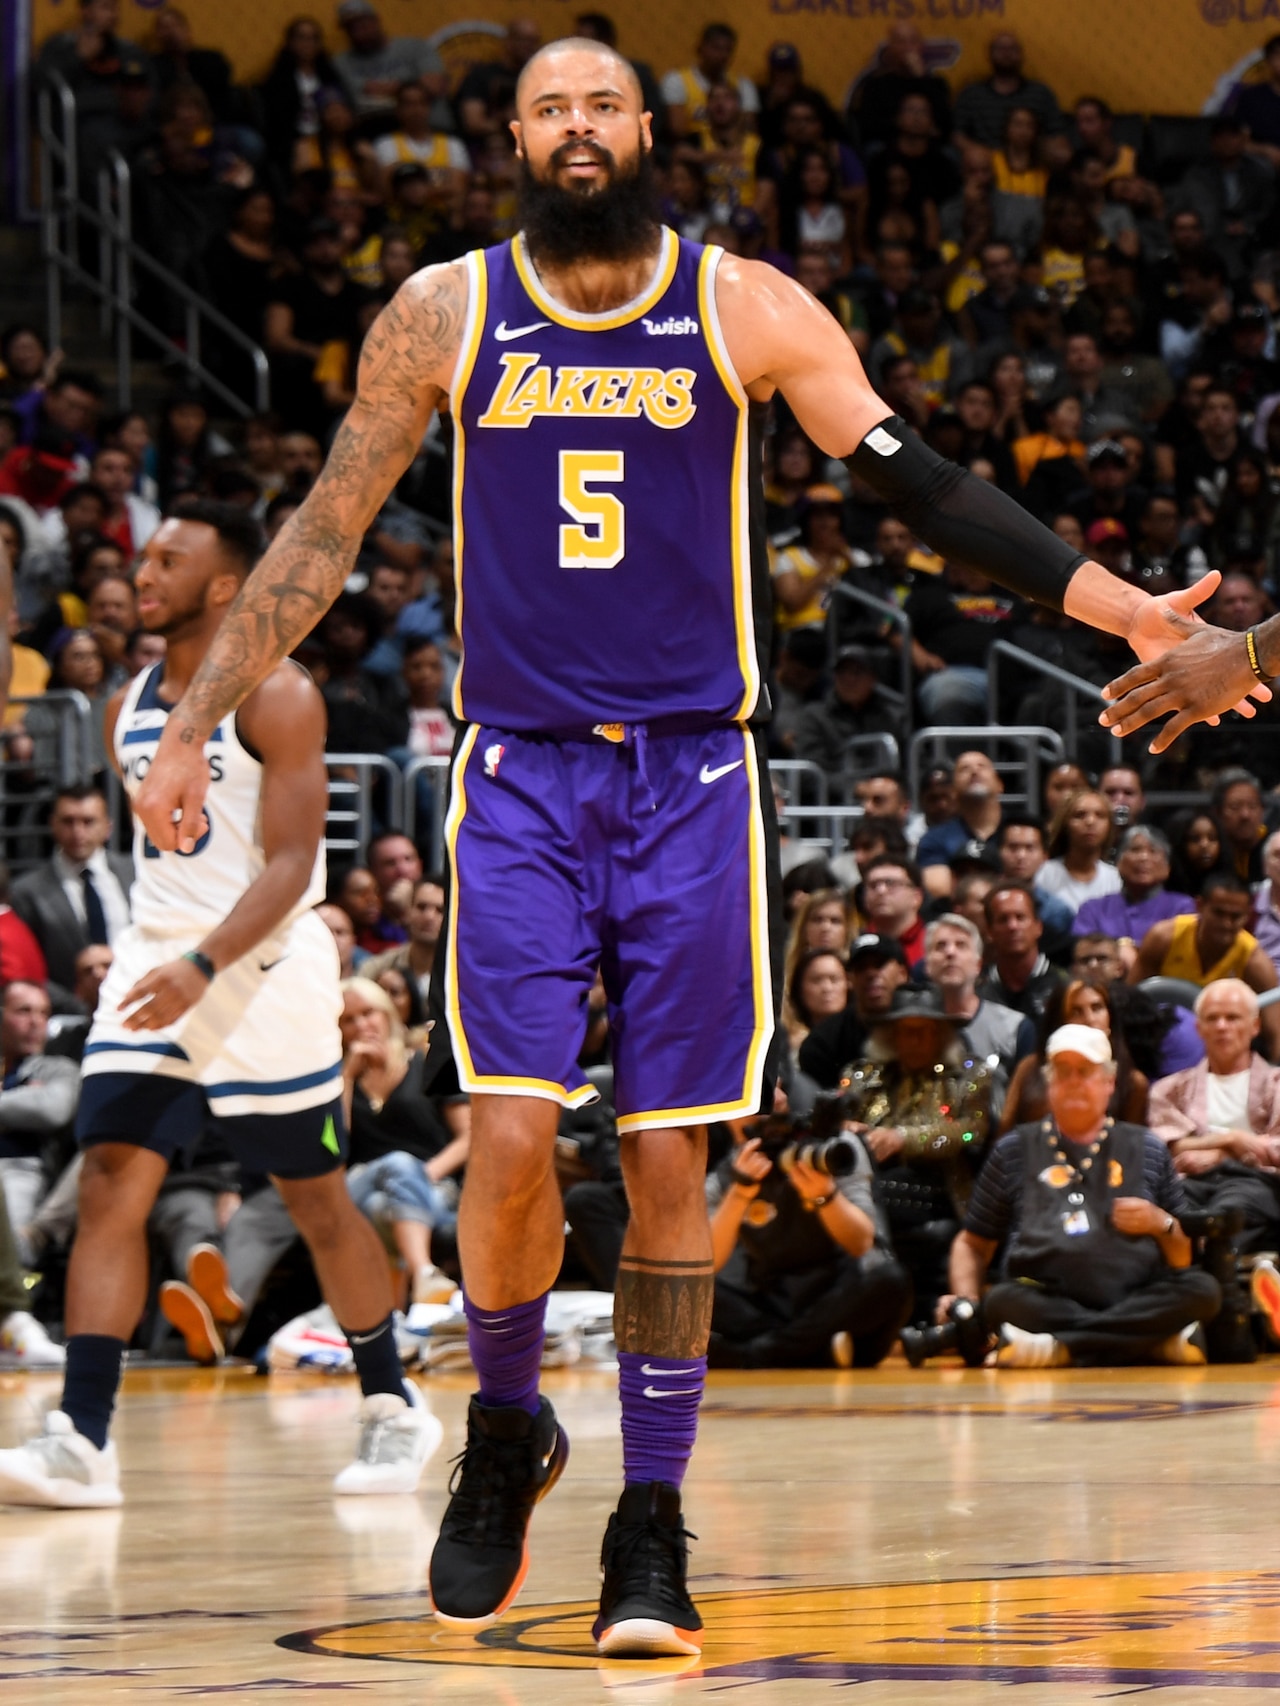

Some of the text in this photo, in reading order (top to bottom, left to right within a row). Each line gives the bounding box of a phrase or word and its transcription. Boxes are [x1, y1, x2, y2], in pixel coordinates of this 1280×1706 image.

[641, 316, 699, 335] wish
[478, 353, 697, 428] LAKERS
[558, 449, 625, 569] 5
